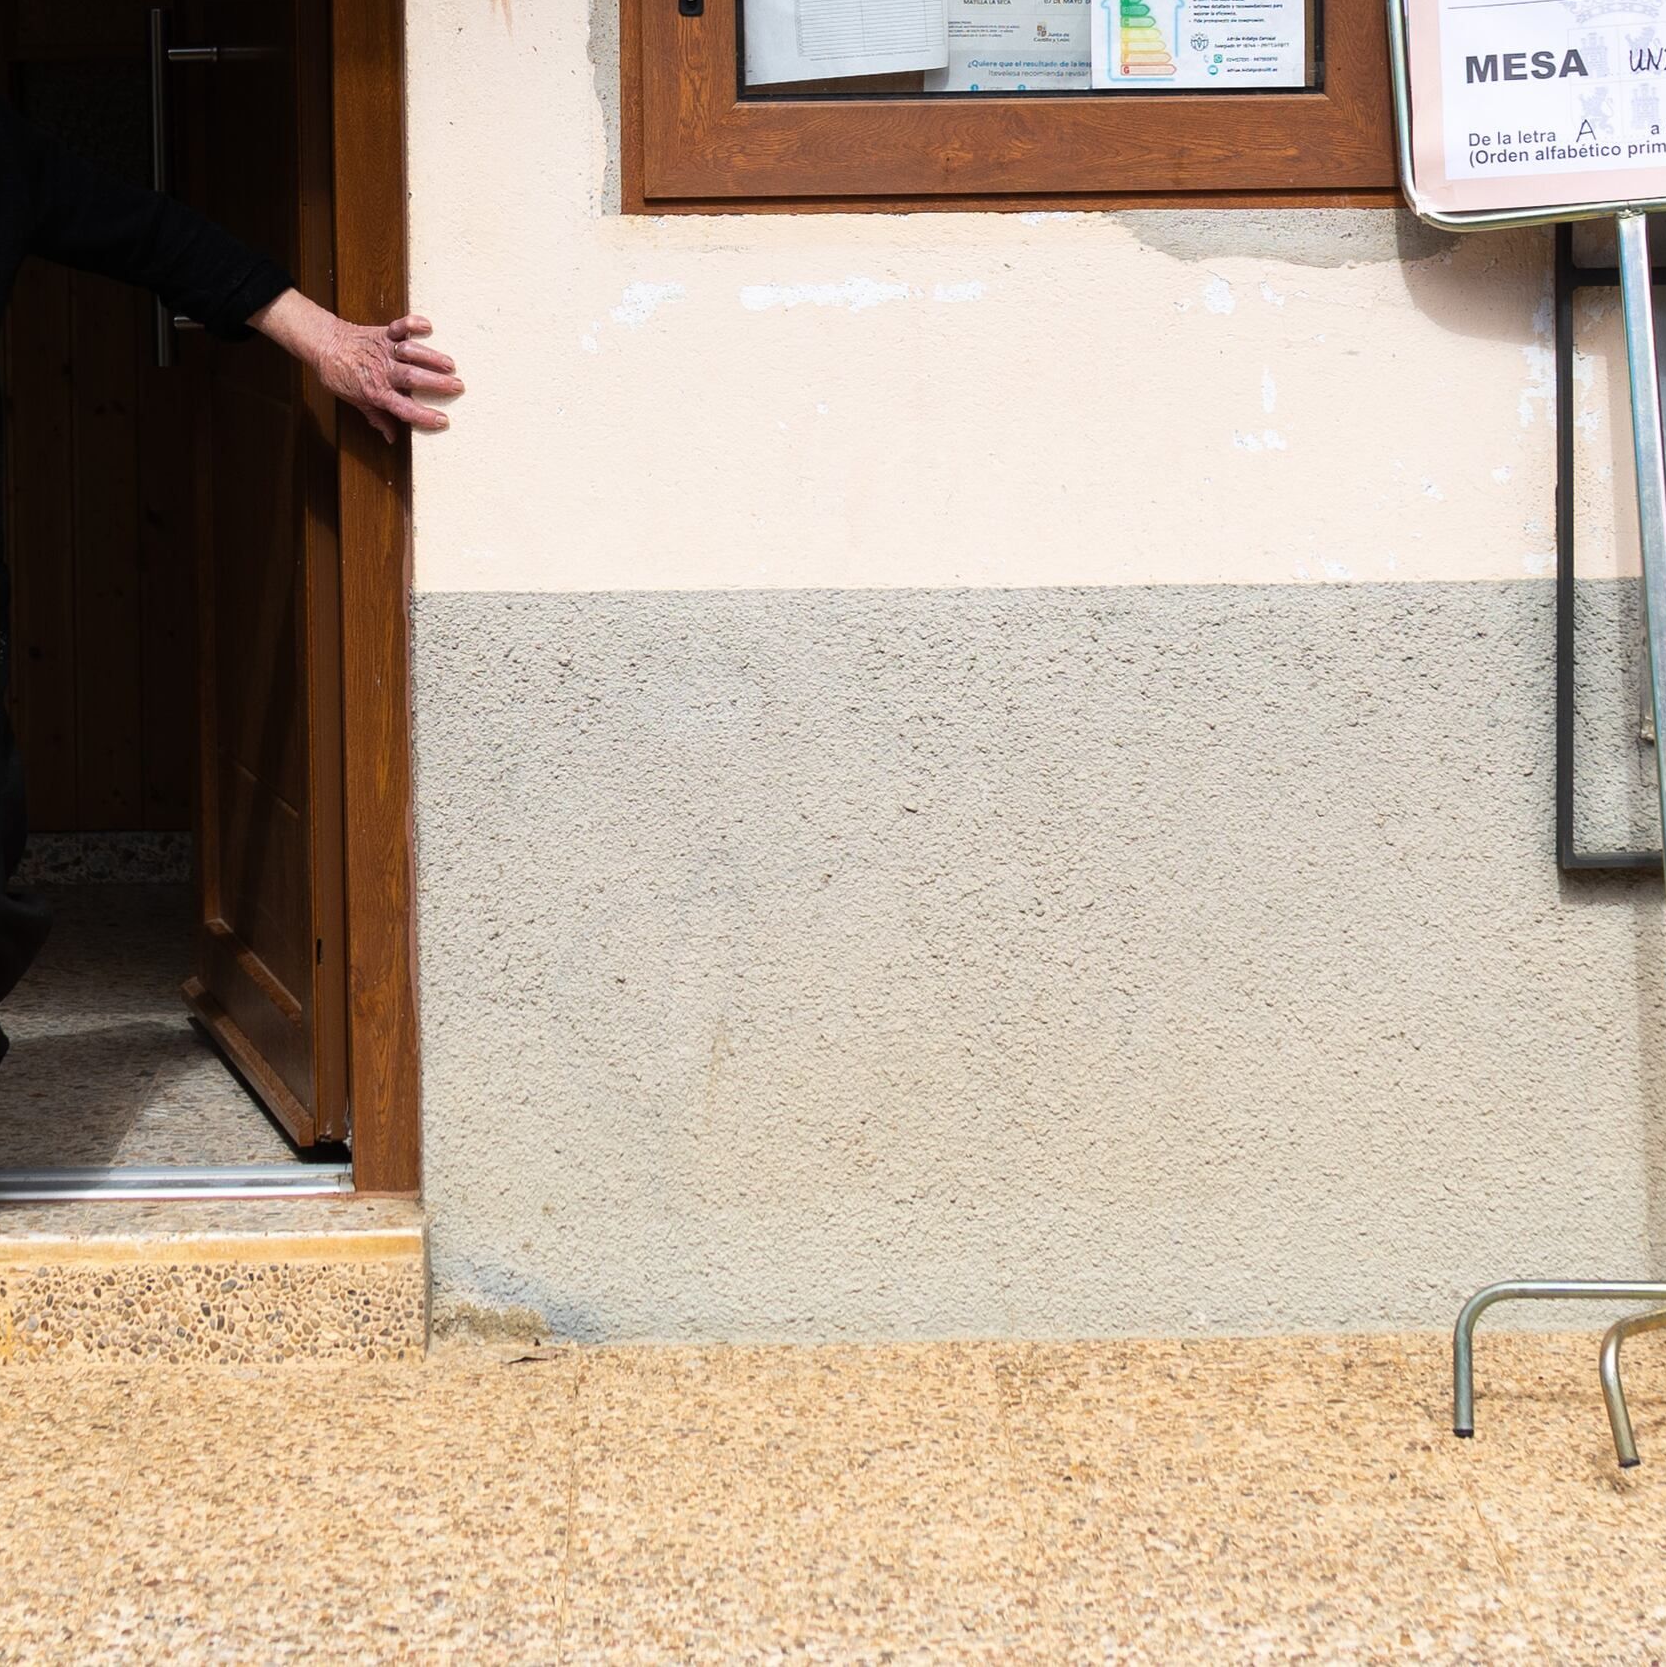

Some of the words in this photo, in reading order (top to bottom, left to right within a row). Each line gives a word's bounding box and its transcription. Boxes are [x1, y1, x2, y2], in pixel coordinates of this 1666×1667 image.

[1465, 48, 1588, 85] MESA
[1468, 132, 1492, 148] De
[1496, 131, 1512, 146] la
[1517, 128, 1556, 145] letra
[1576, 119, 1597, 143] A
[1650, 122, 1661, 135] a
[1468, 149, 1531, 168] (Orden
[1535, 141, 1622, 161] alfabético
